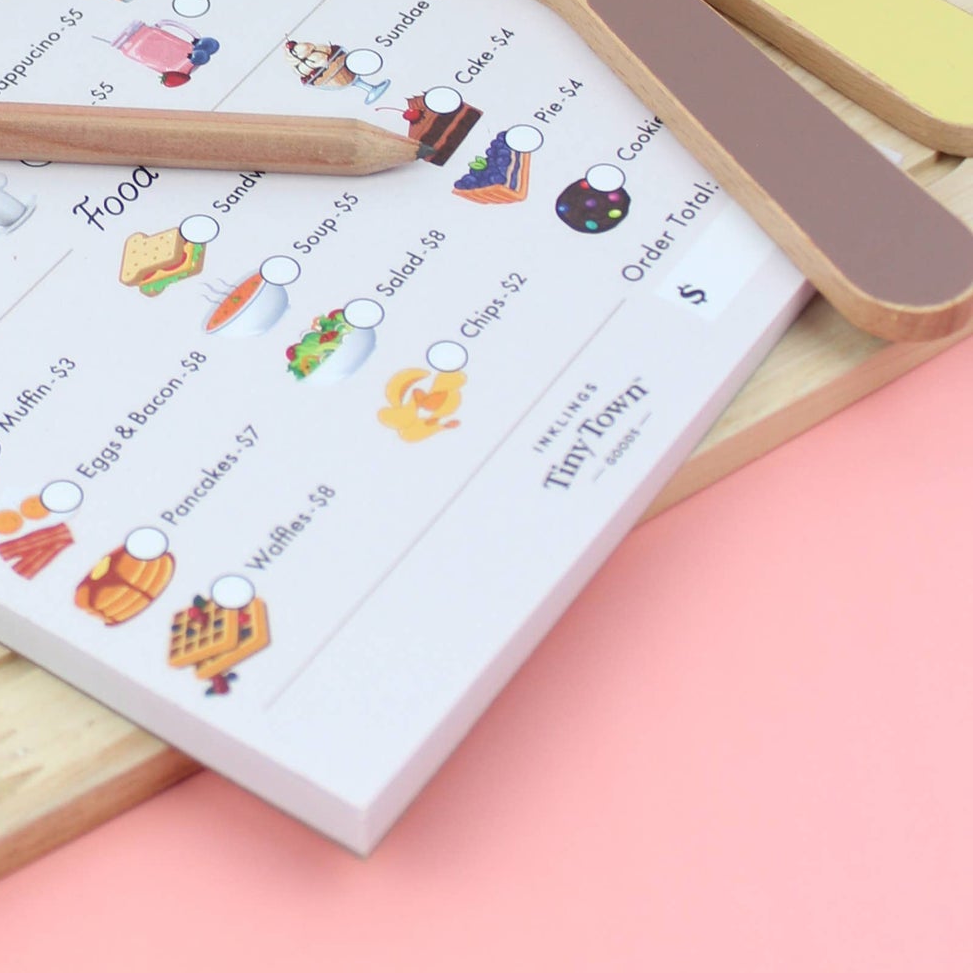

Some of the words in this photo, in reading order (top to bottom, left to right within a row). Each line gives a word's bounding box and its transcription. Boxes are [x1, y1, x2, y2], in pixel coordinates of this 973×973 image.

[621, 230, 676, 282] Order
[665, 181, 720, 227] Total:
[676, 283, 708, 306] $
[532, 382, 598, 454] INKLINGS
[75, 438, 123, 480] Eggs
[114, 424, 139, 440] &
